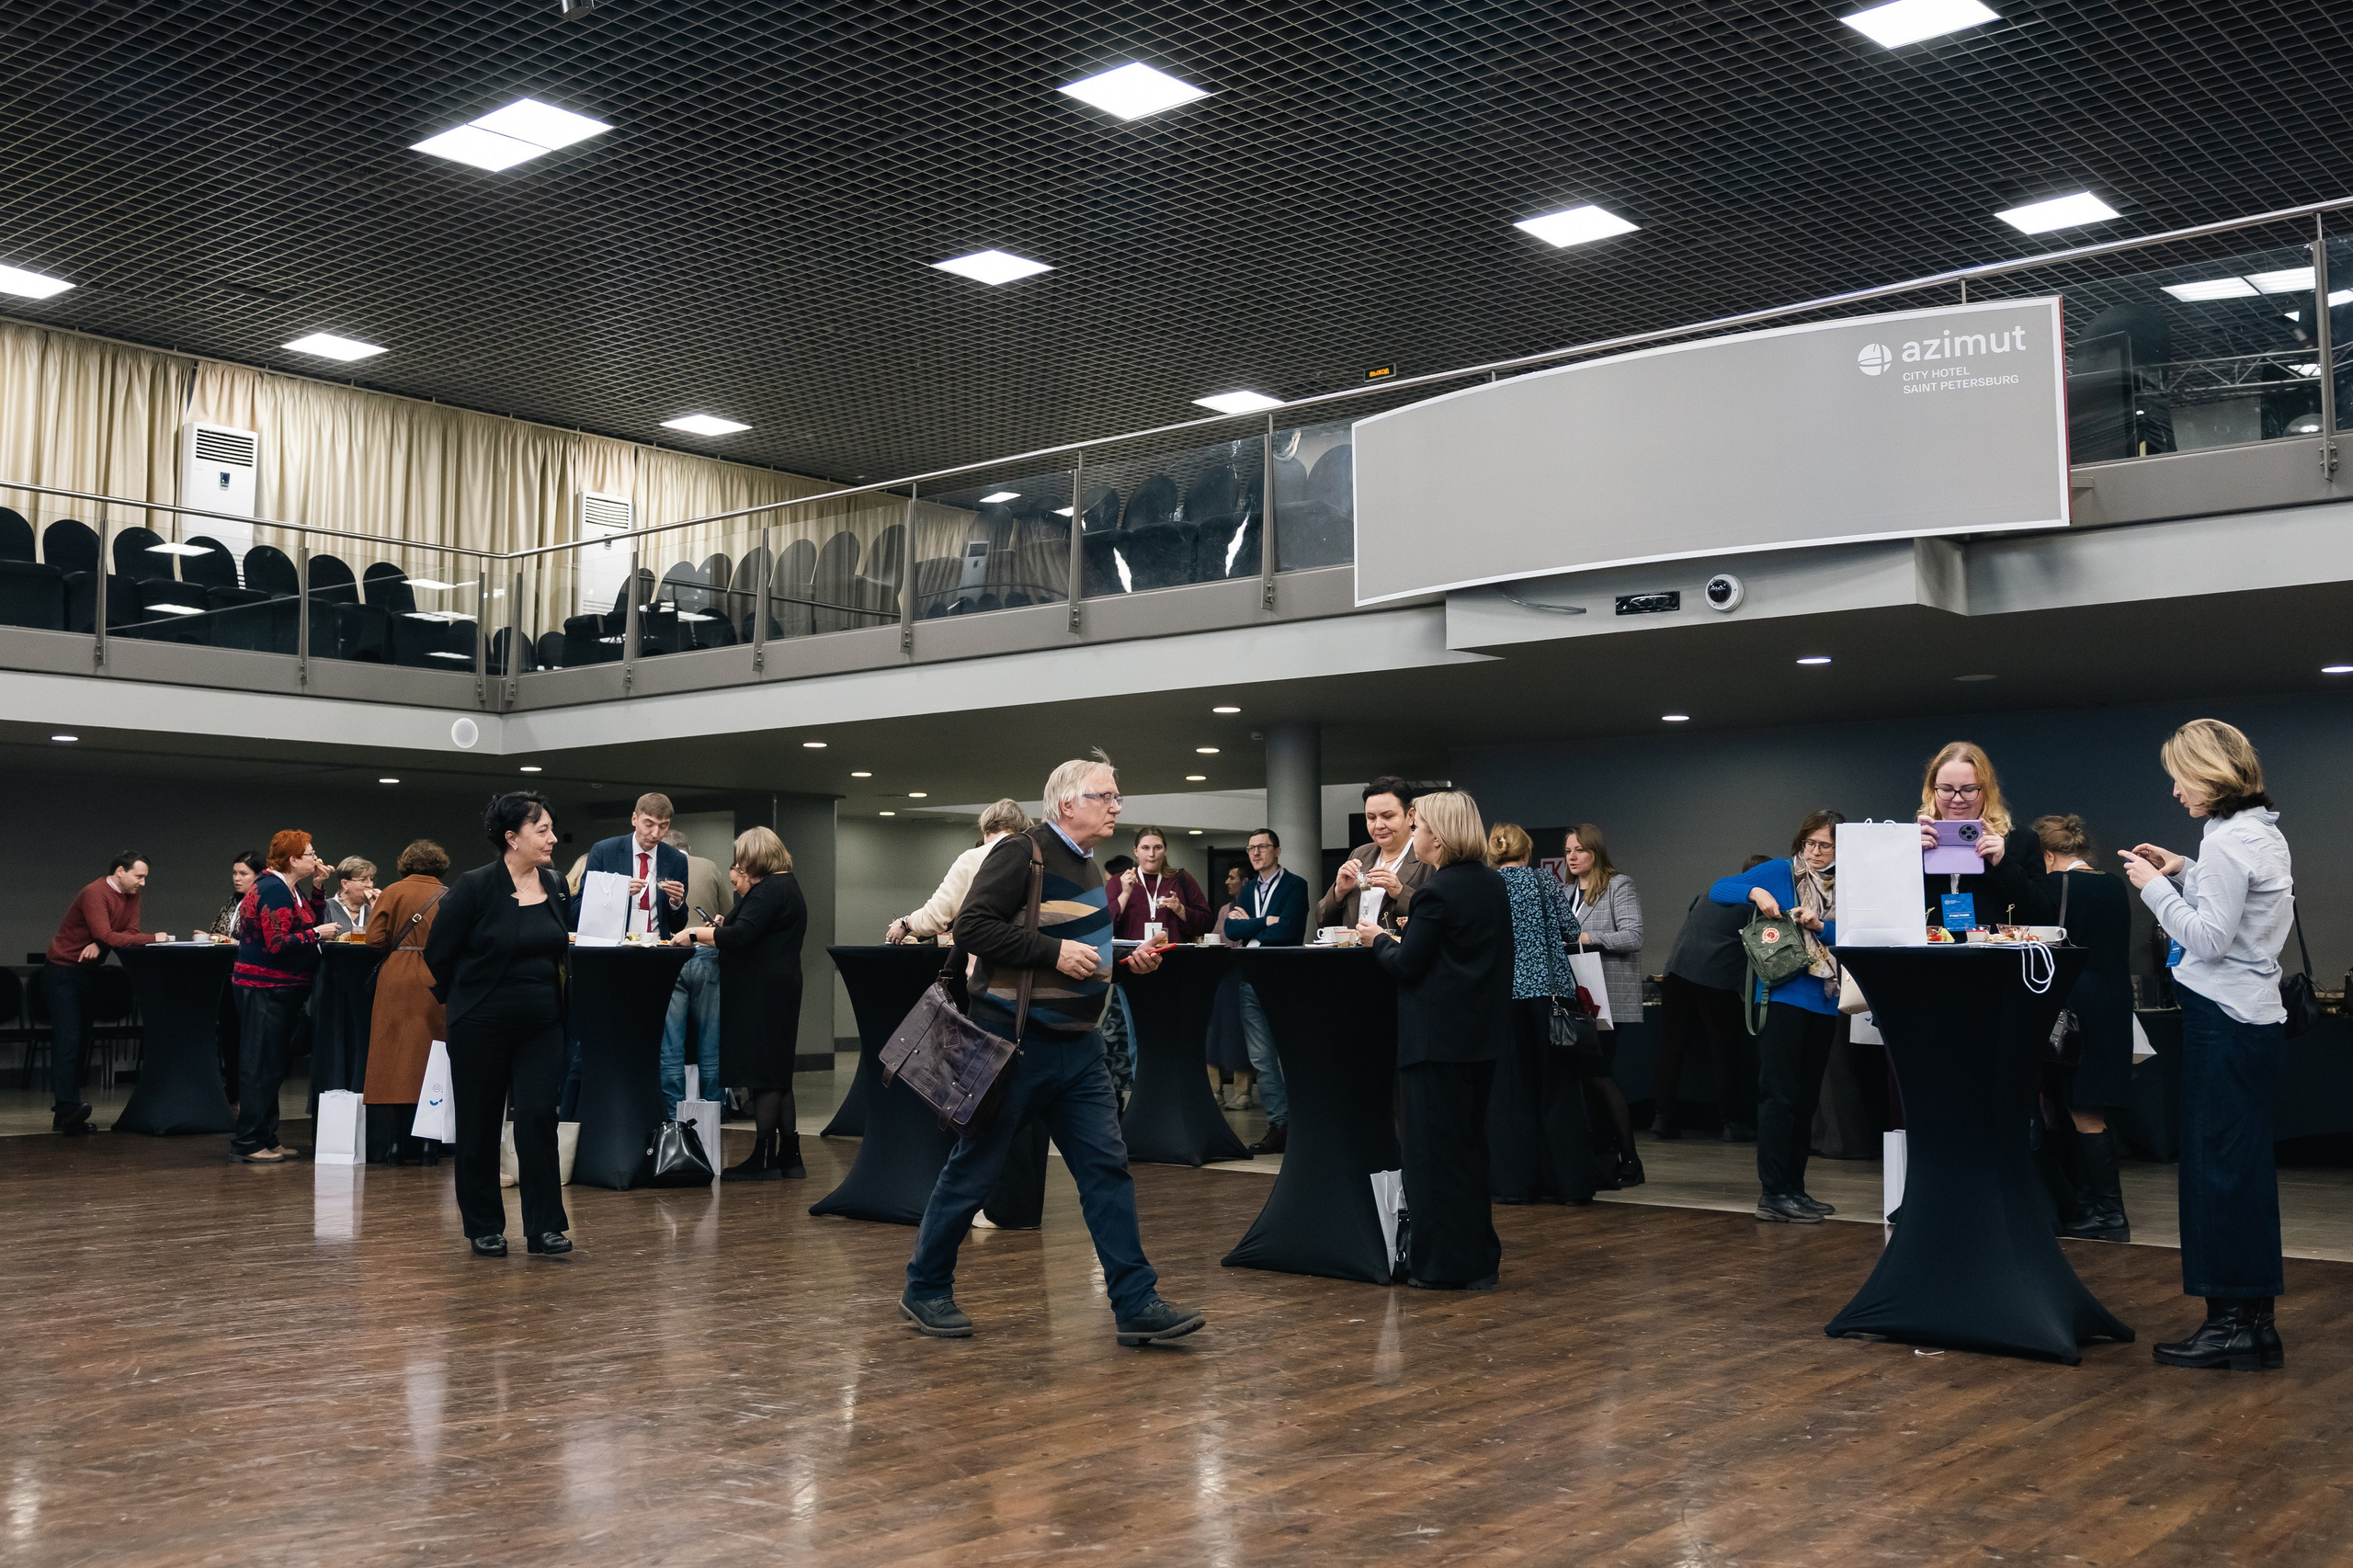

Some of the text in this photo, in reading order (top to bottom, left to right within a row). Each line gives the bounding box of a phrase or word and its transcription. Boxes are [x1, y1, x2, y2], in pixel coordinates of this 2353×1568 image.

[1902, 325, 2027, 363] azimut
[1903, 367, 1971, 381] CITY HOTEL
[1903, 374, 2019, 394] SAINT PETERSBURG
